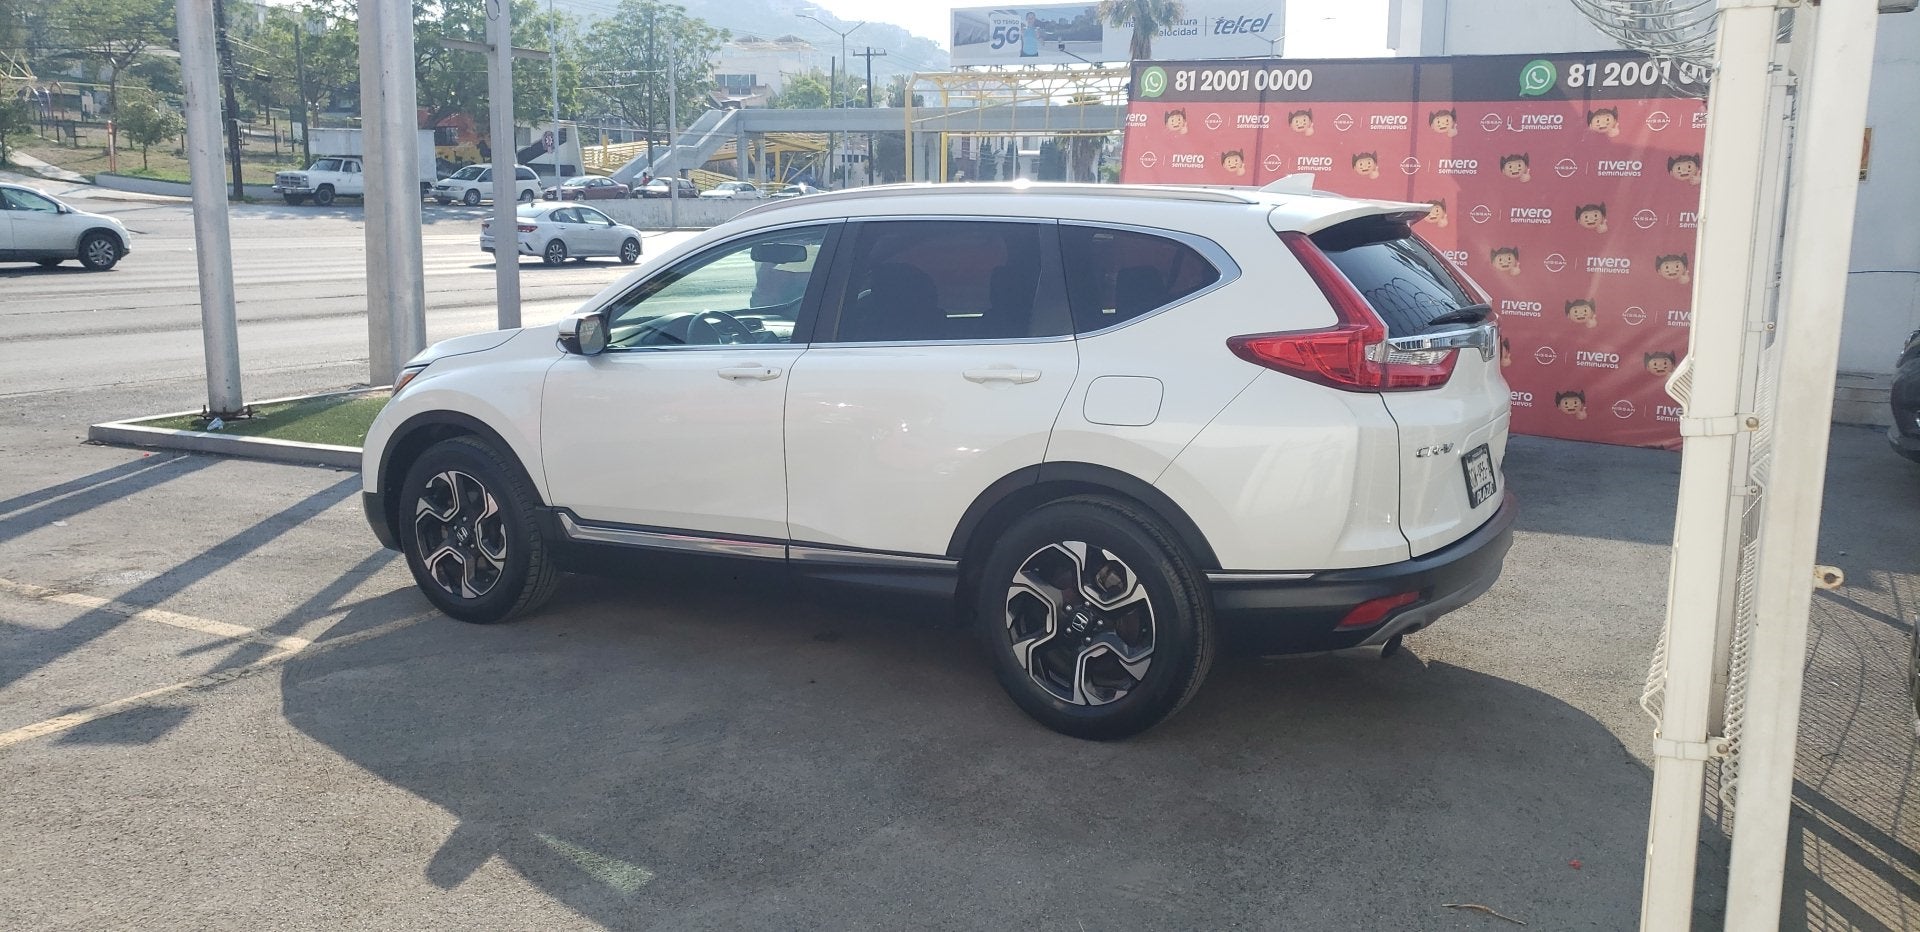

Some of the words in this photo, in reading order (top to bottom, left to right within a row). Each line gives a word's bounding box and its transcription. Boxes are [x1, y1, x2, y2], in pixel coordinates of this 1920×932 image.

[1213, 13, 1273, 34] telcel
[1158, 28, 1198, 36] elocidad
[991, 26, 1020, 50] 5G
[1567, 64, 1597, 86] 81
[1602, 61, 1672, 87] 2001
[1174, 70, 1196, 90] 81
[1200, 70, 1250, 90] 2001
[1254, 69, 1313, 90] 0000
[1126, 114, 1147, 122] vero
[1236, 114, 1270, 123] rivero
[1370, 115, 1408, 124] rivero
[1521, 114, 1563, 124] rivero
[1172, 154, 1204, 163] rivero
[1297, 156, 1332, 166] rivero
[1438, 159, 1478, 169] rivero
[1598, 160, 1642, 170] rivero
[1510, 207, 1552, 218] rivero
[1442, 250, 1468, 260] vero
[1586, 256, 1630, 268] rivero
[1501, 300, 1542, 311] rivero
[1576, 350, 1620, 363] rivero
